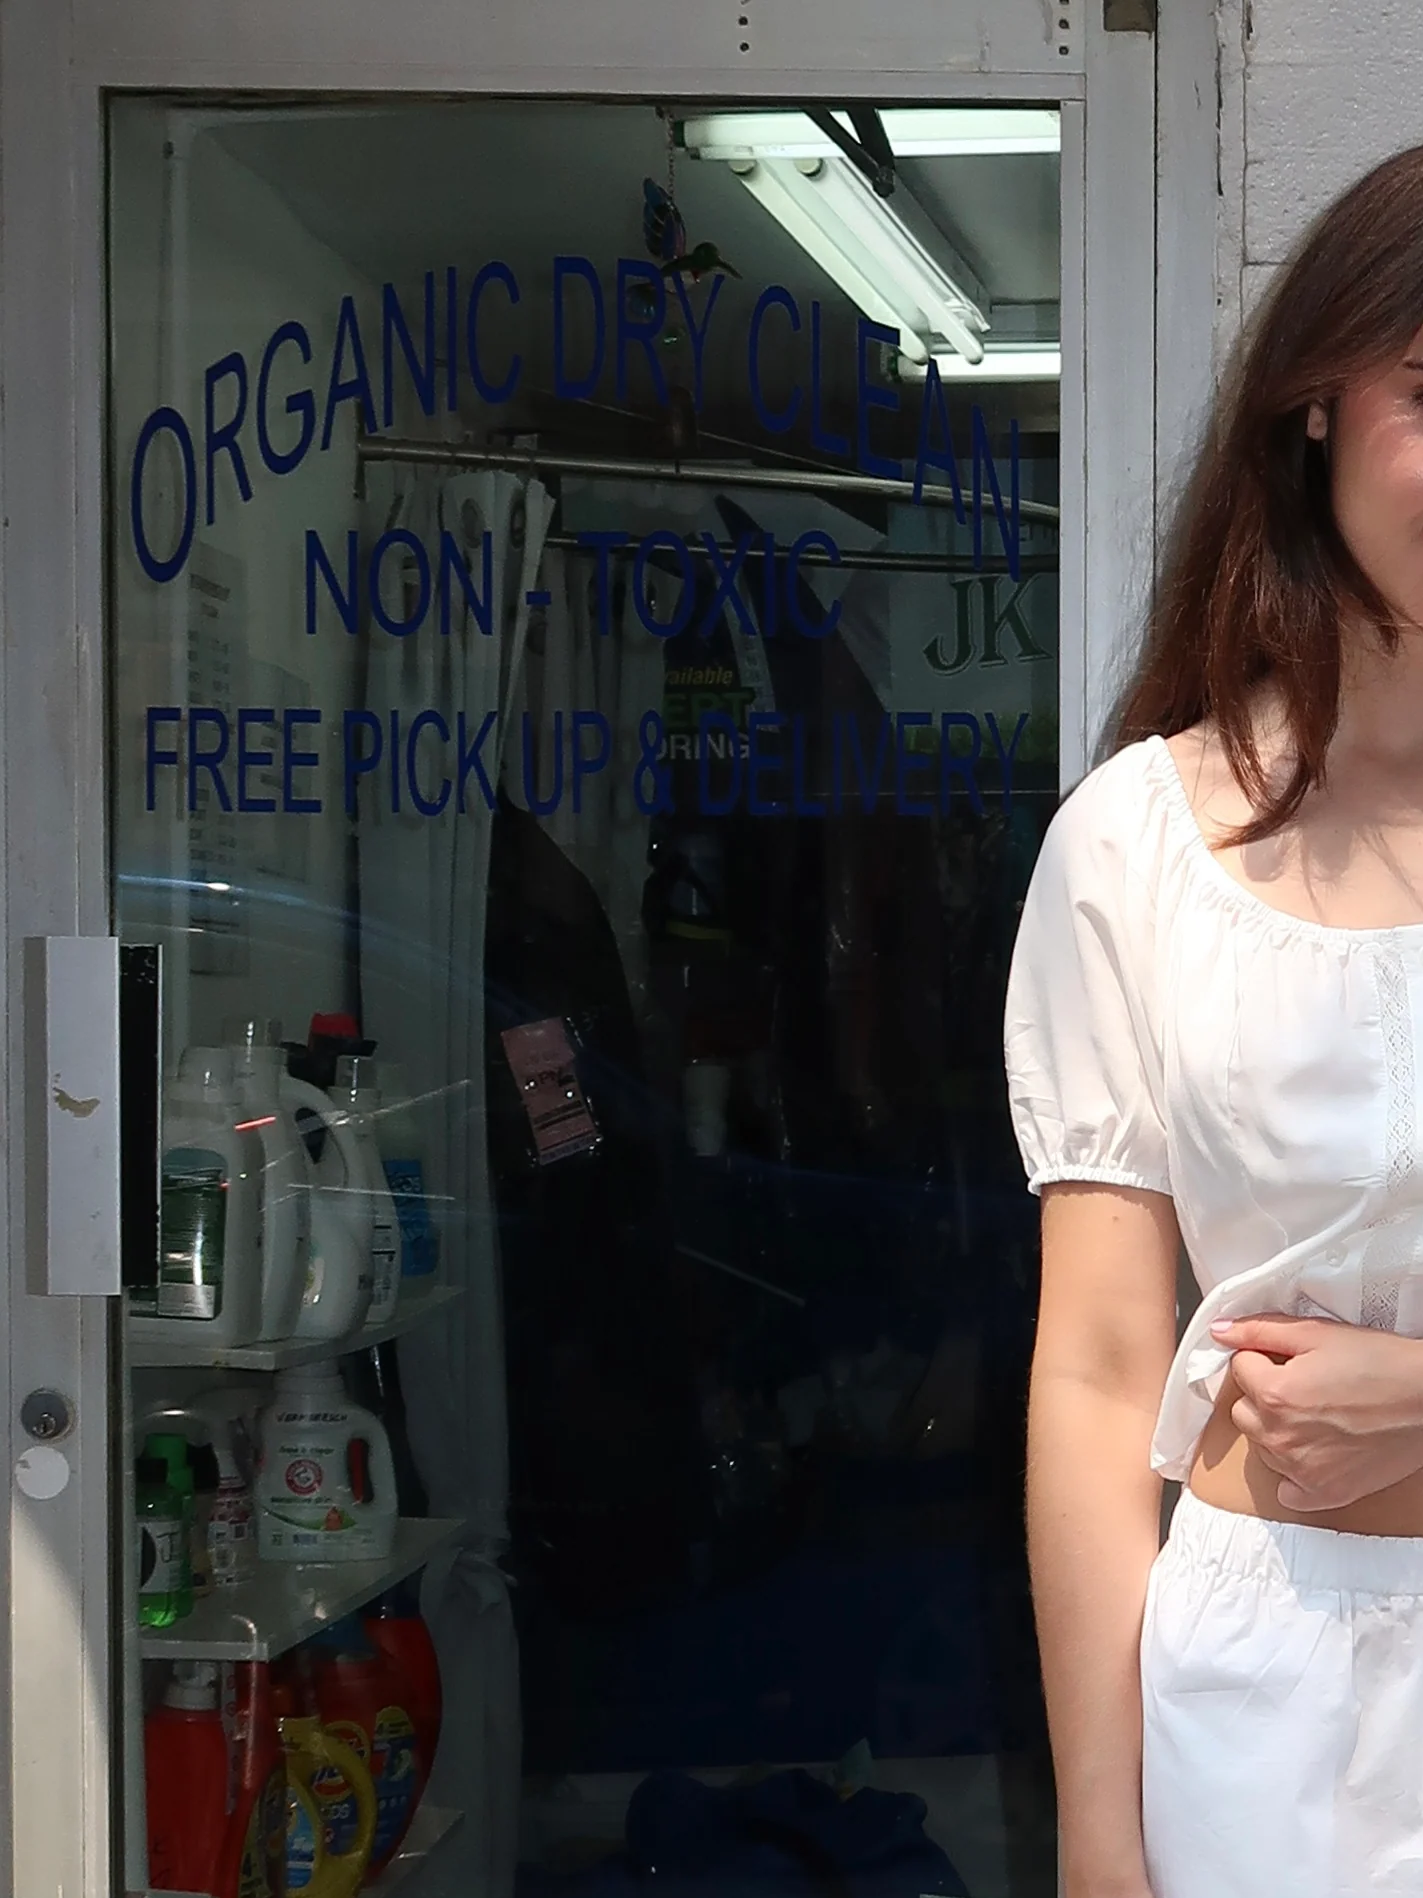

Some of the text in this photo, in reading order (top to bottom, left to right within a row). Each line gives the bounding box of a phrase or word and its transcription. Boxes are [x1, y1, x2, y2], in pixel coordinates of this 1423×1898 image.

[131, 256, 1020, 583] ORGANIC DRY CLEAN
[305, 530, 493, 636] NON
[526, 591, 551, 605] -
[578, 530, 843, 639] TOXIC
[911, 574, 1053, 678] JK
[146, 707, 321, 812] FREE
[344, 709, 498, 816] PICK
[522, 710, 610, 816] UP
[634, 709, 675, 816] &
[703, 711, 1028, 816] DELIVERY
